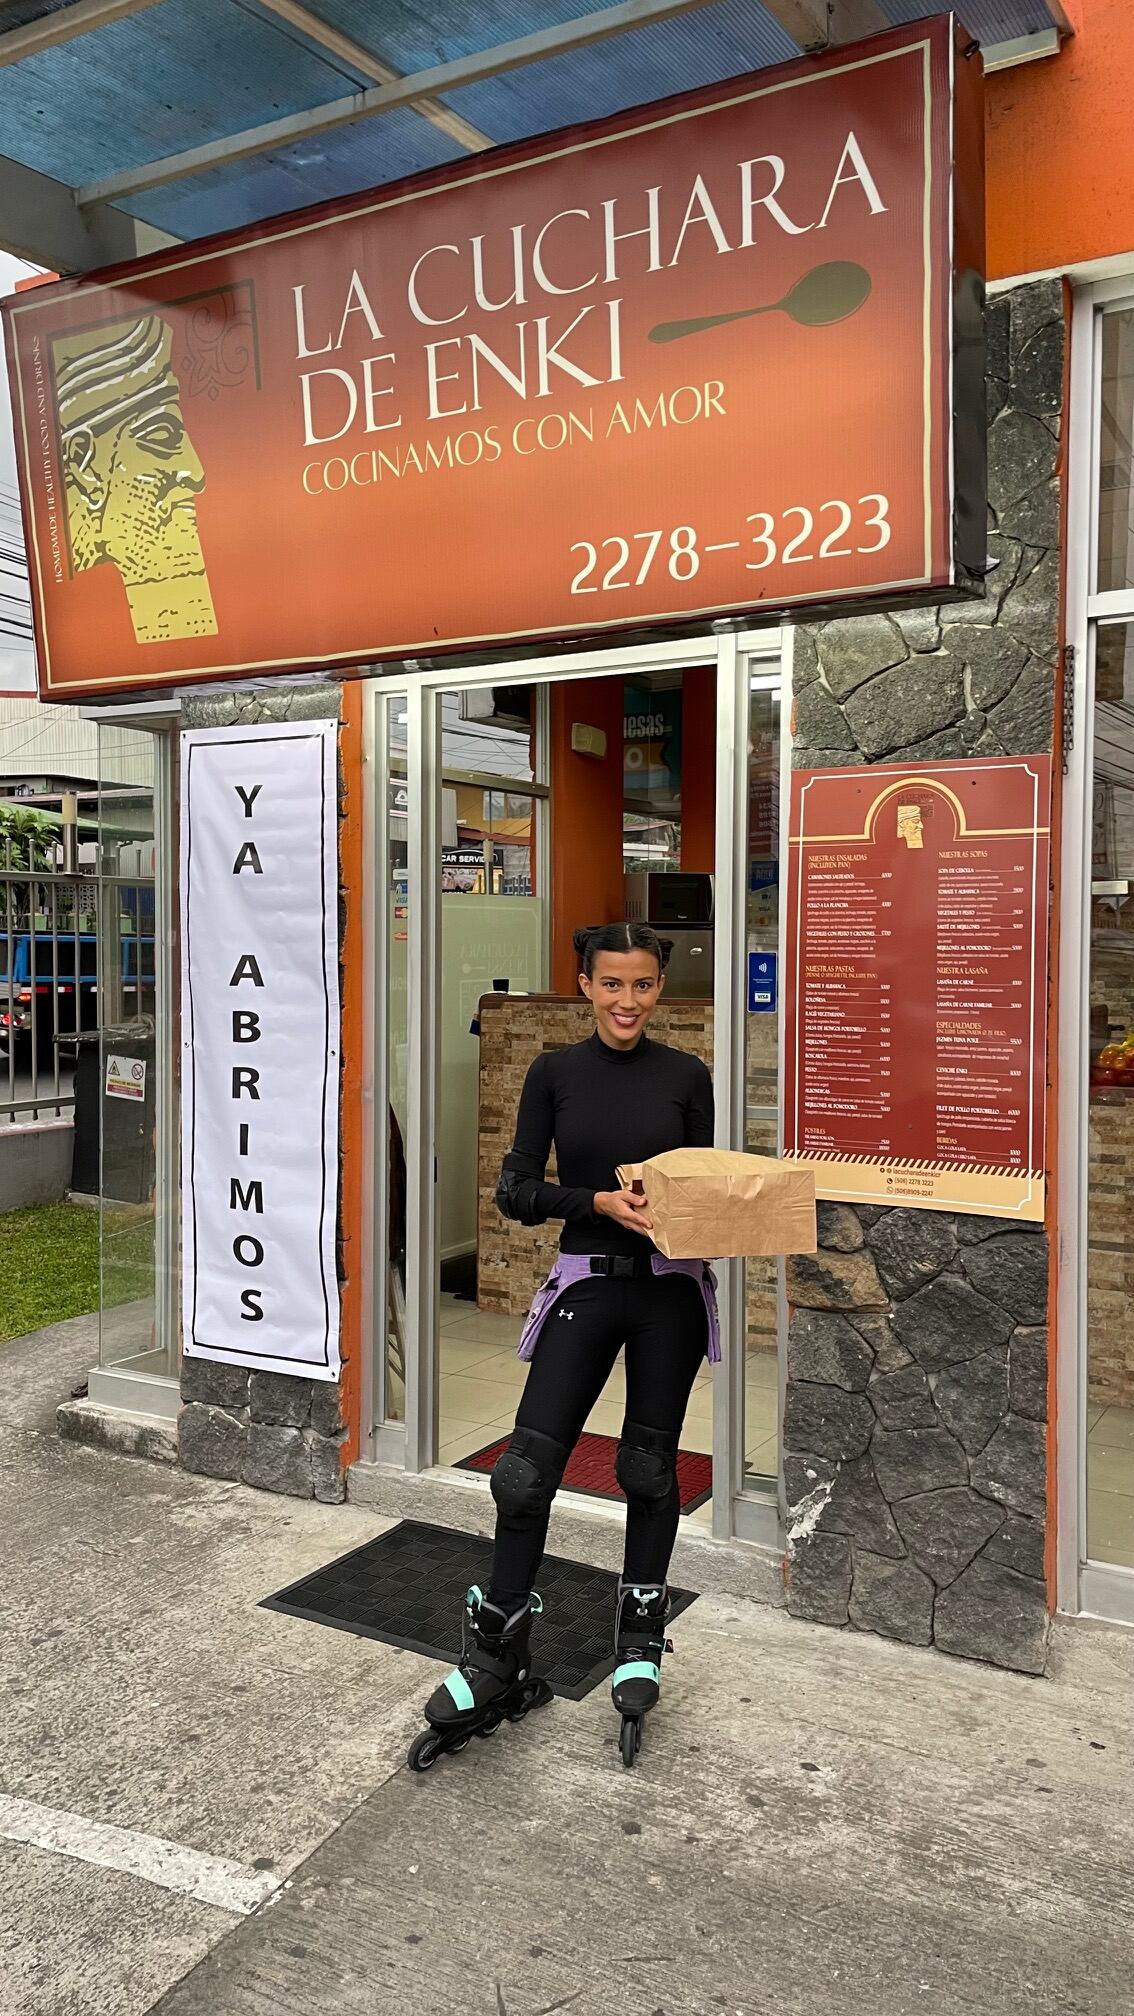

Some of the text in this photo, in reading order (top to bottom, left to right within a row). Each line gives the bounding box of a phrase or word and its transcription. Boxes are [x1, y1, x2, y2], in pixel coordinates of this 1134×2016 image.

[292, 131, 889, 359] LA CUCHARA
[37, 387, 45, 415] AND
[298, 299, 625, 446] DE ENKI
[303, 381, 727, 495] COCINAMOS CON AMOR
[570, 494, 891, 594] 2278-3223
[969, 850, 988, 858] SOPAS
[964, 966, 989, 974] LASAÑA
[229, 785, 264, 1322] YA ABRIMOS
[936, 1021, 982, 1030] ESPECIALIDADES
